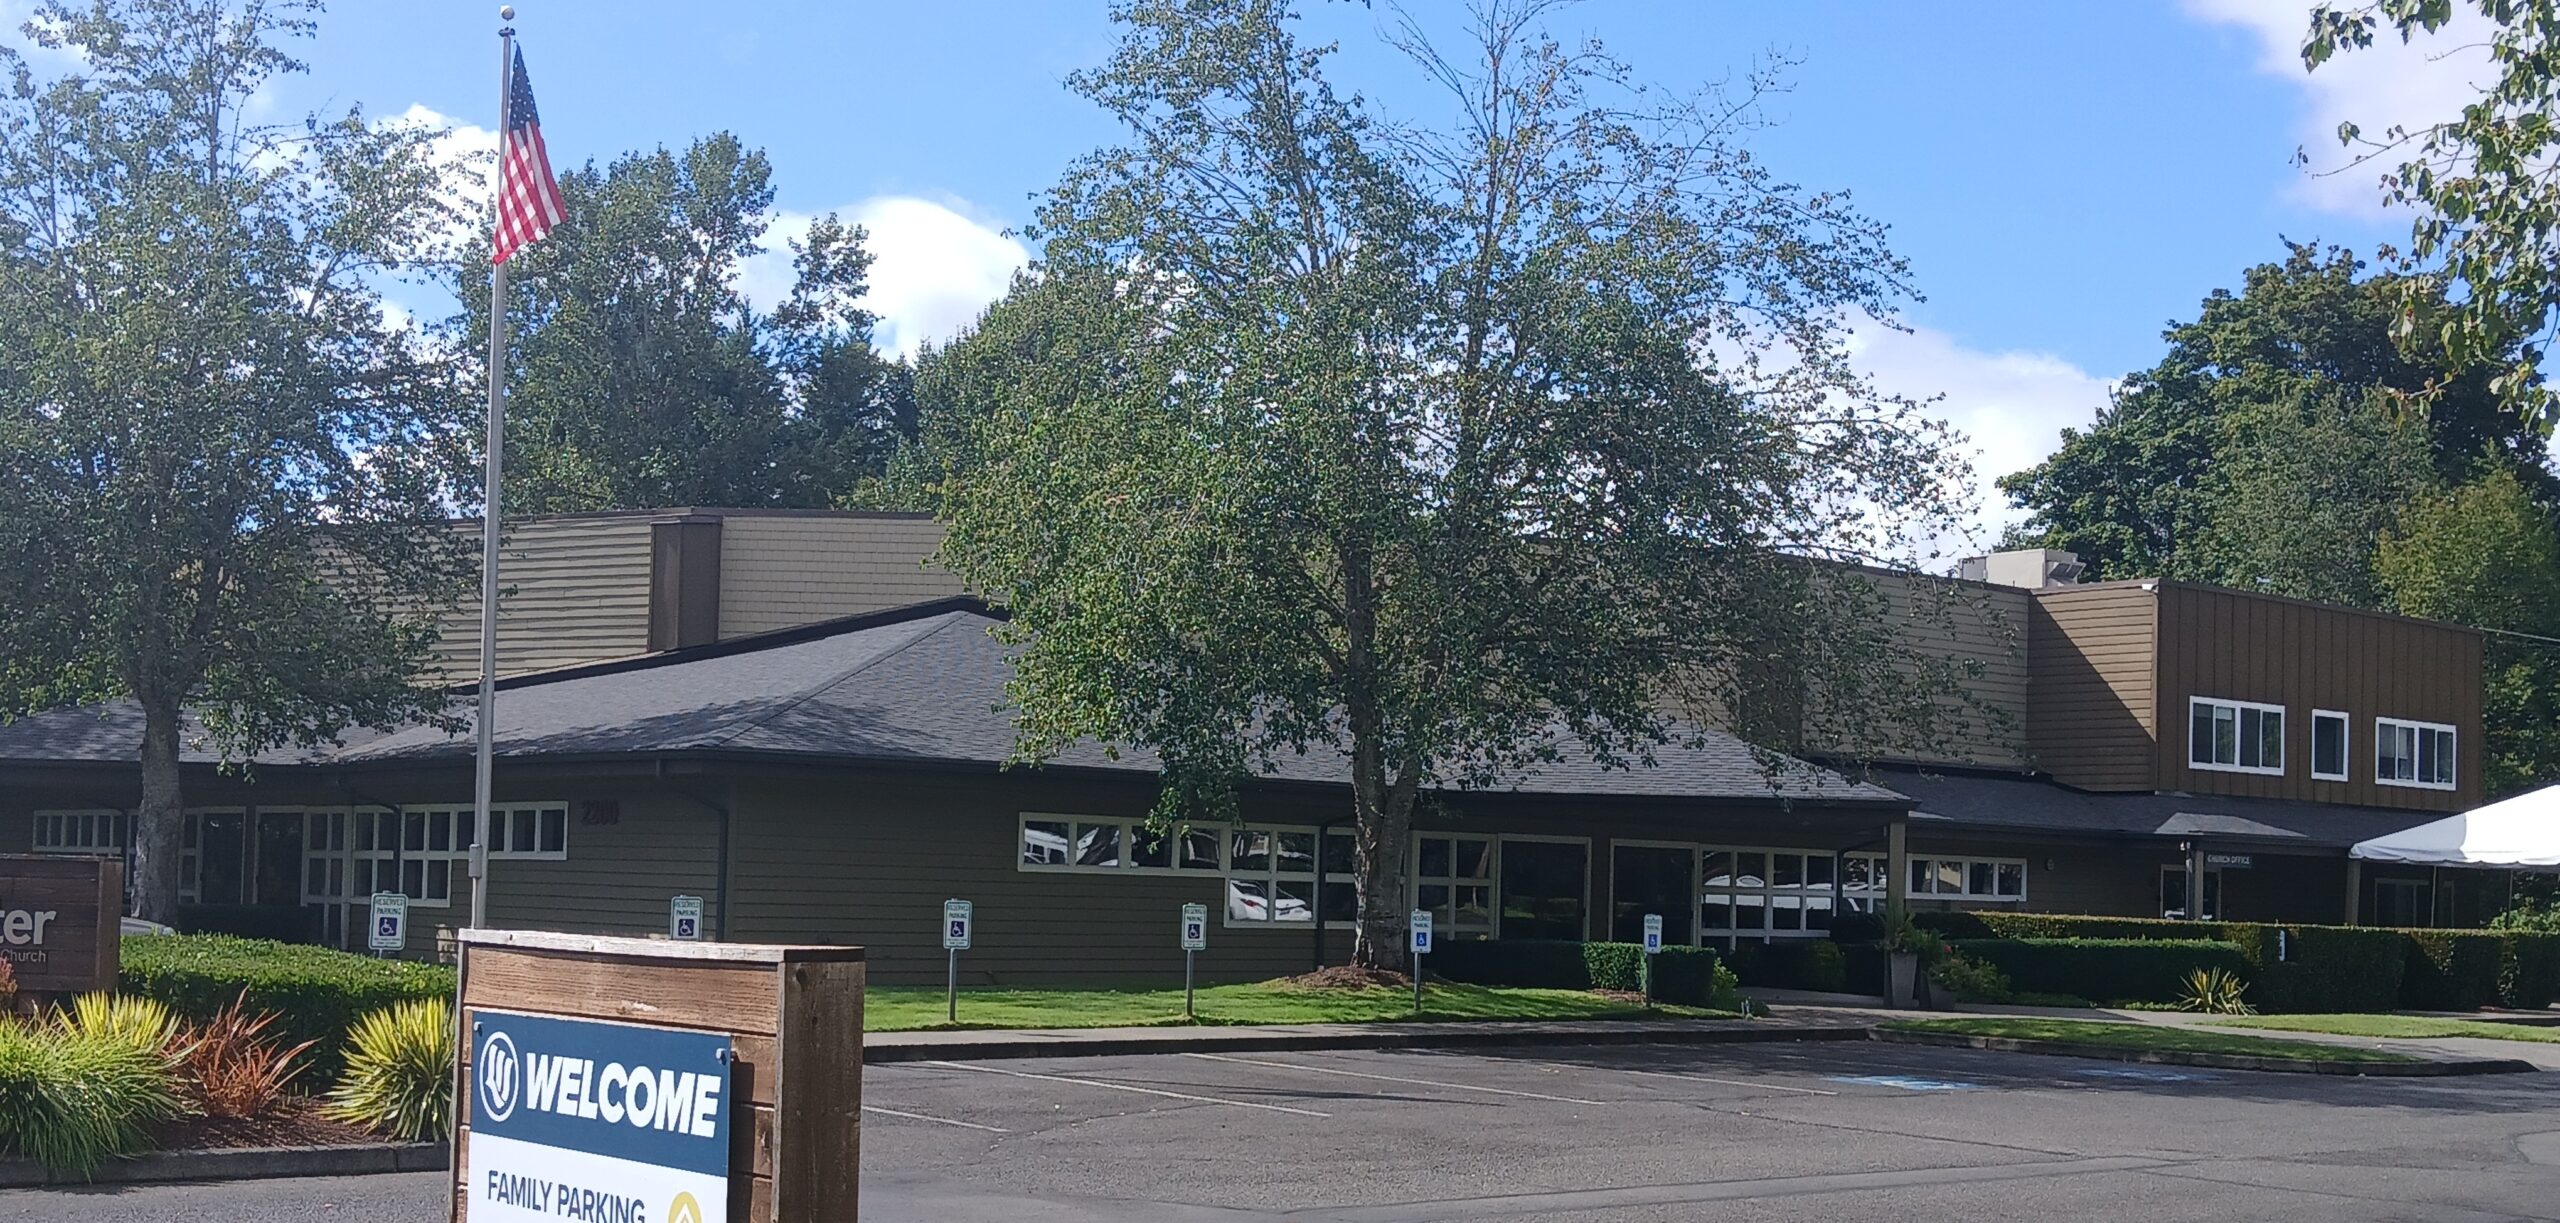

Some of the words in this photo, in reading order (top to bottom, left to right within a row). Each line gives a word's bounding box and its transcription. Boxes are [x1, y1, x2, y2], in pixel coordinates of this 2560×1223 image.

[377, 907, 402, 915] PARKING
[1, 948, 46, 963] Church
[526, 1052, 722, 1138] WELCOME
[488, 1169, 553, 1213] FAMILY
[557, 1183, 646, 1223] PARKING
